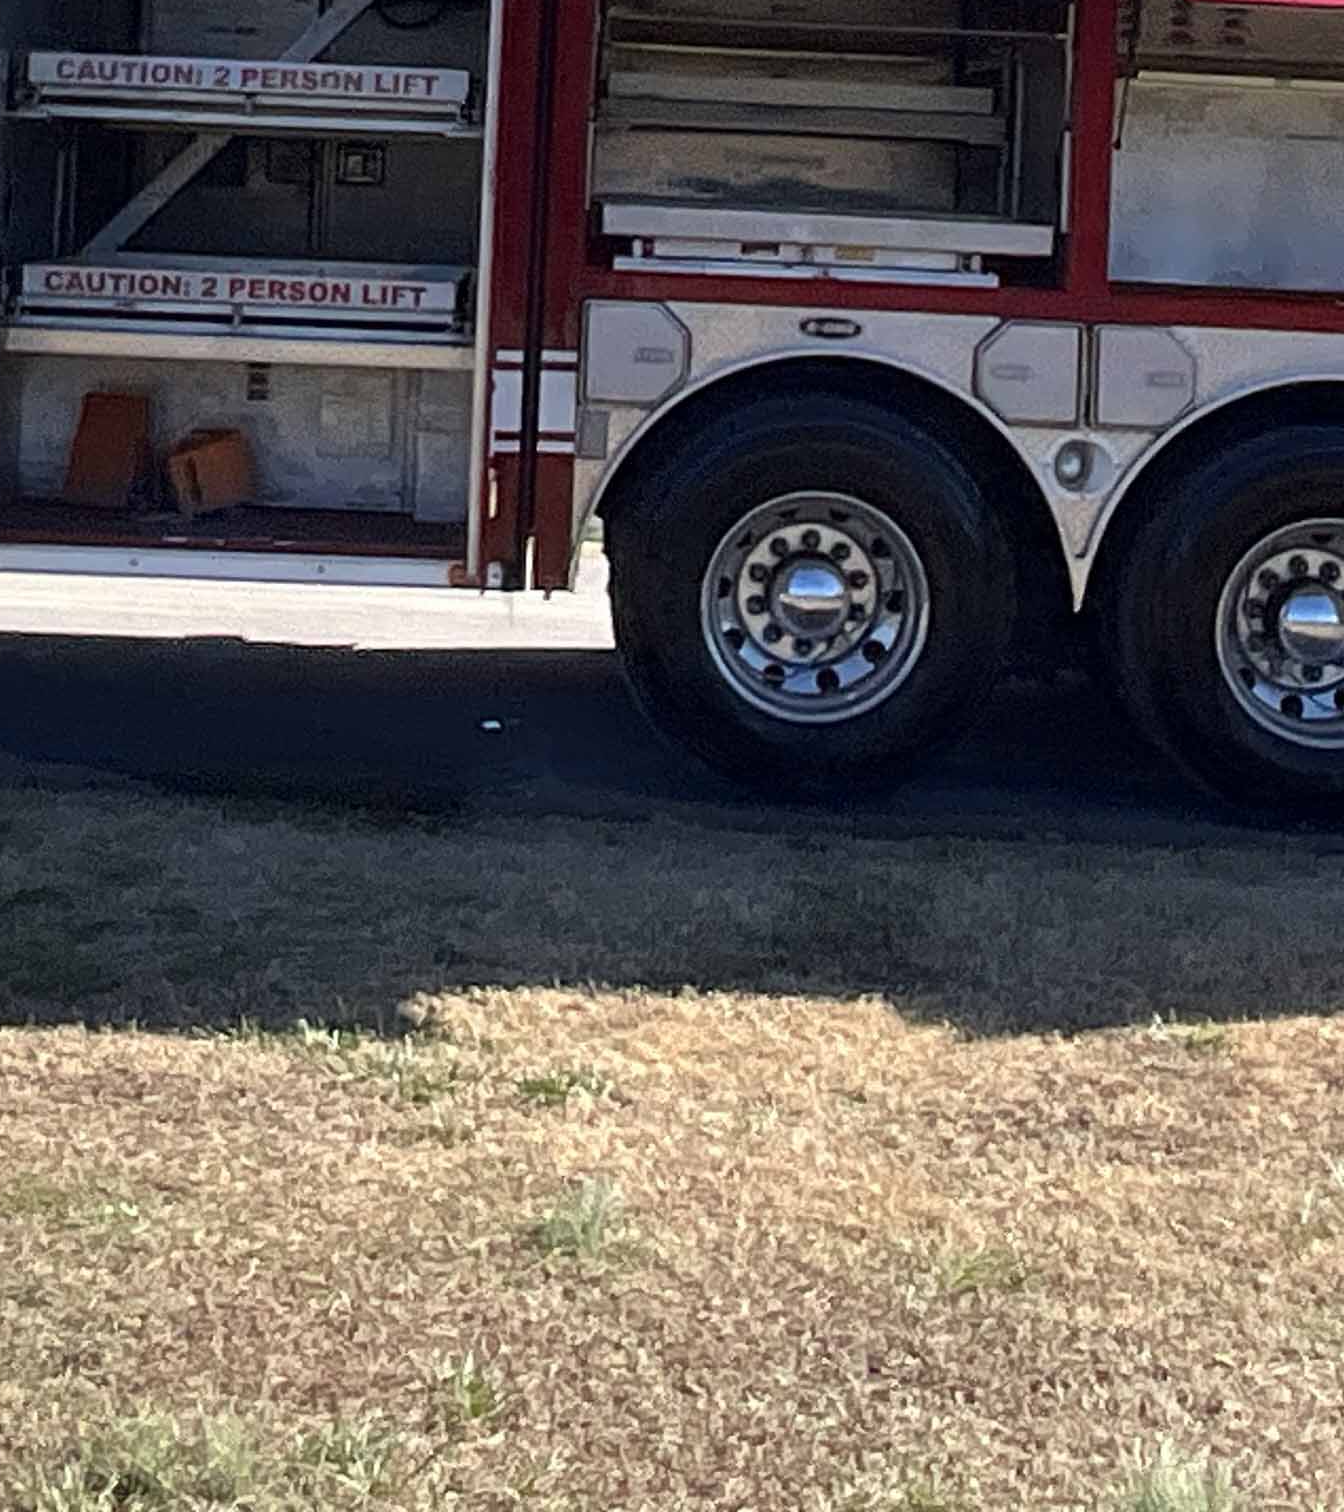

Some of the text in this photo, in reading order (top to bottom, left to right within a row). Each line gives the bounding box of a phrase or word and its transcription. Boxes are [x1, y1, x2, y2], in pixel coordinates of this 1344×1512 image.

[57, 59, 441, 97] CAUTION: 2 PERSON LIFT
[44, 271, 428, 308] CAUTION: 2 PERSON LIFT
